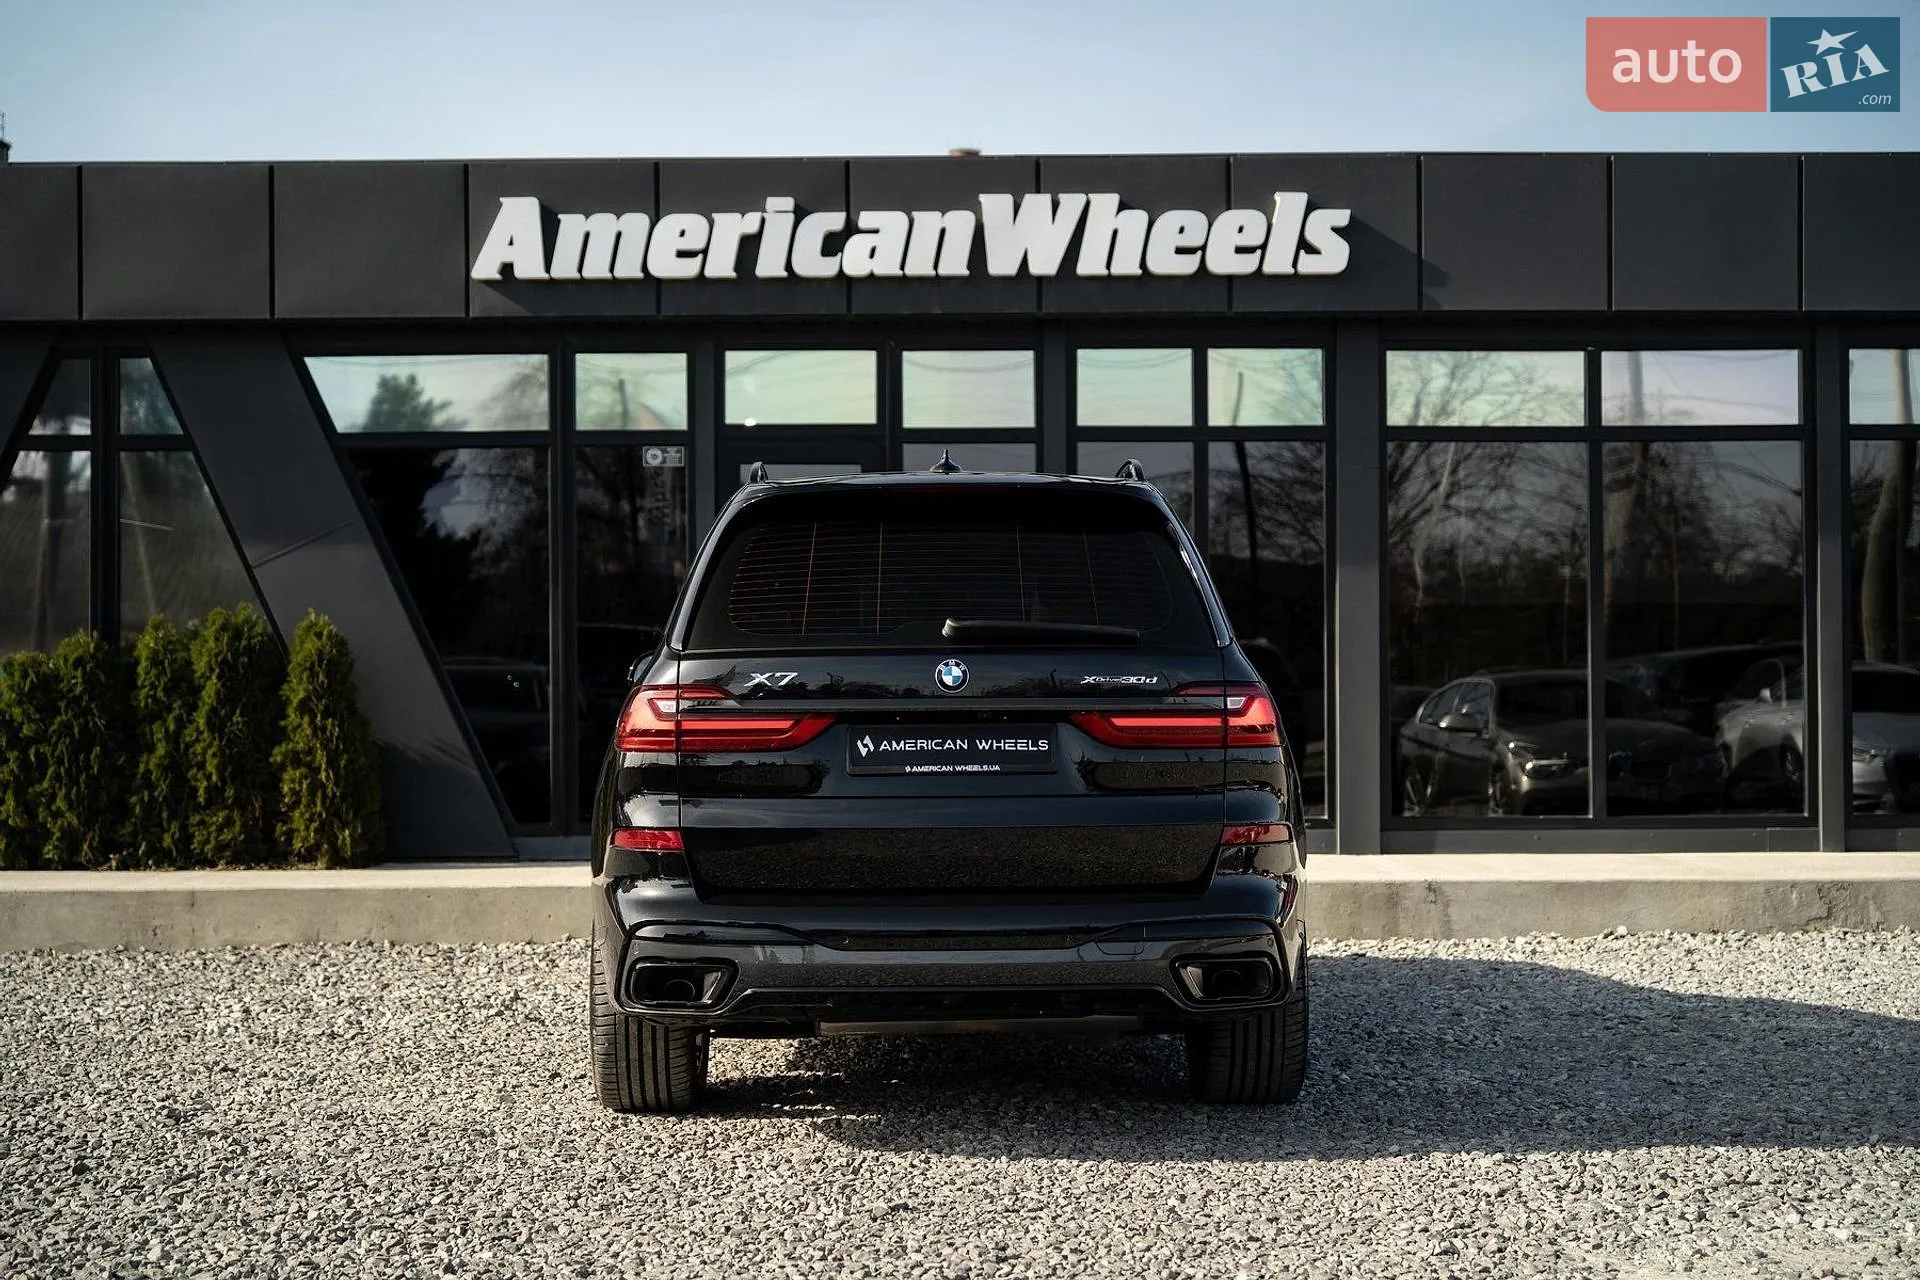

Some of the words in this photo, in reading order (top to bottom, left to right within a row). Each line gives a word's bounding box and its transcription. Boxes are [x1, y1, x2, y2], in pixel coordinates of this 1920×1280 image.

[743, 672, 798, 687] X7
[879, 739, 968, 751] AMERICAN
[976, 739, 1049, 750] WHEELS
[911, 765, 953, 773] AMERICAN
